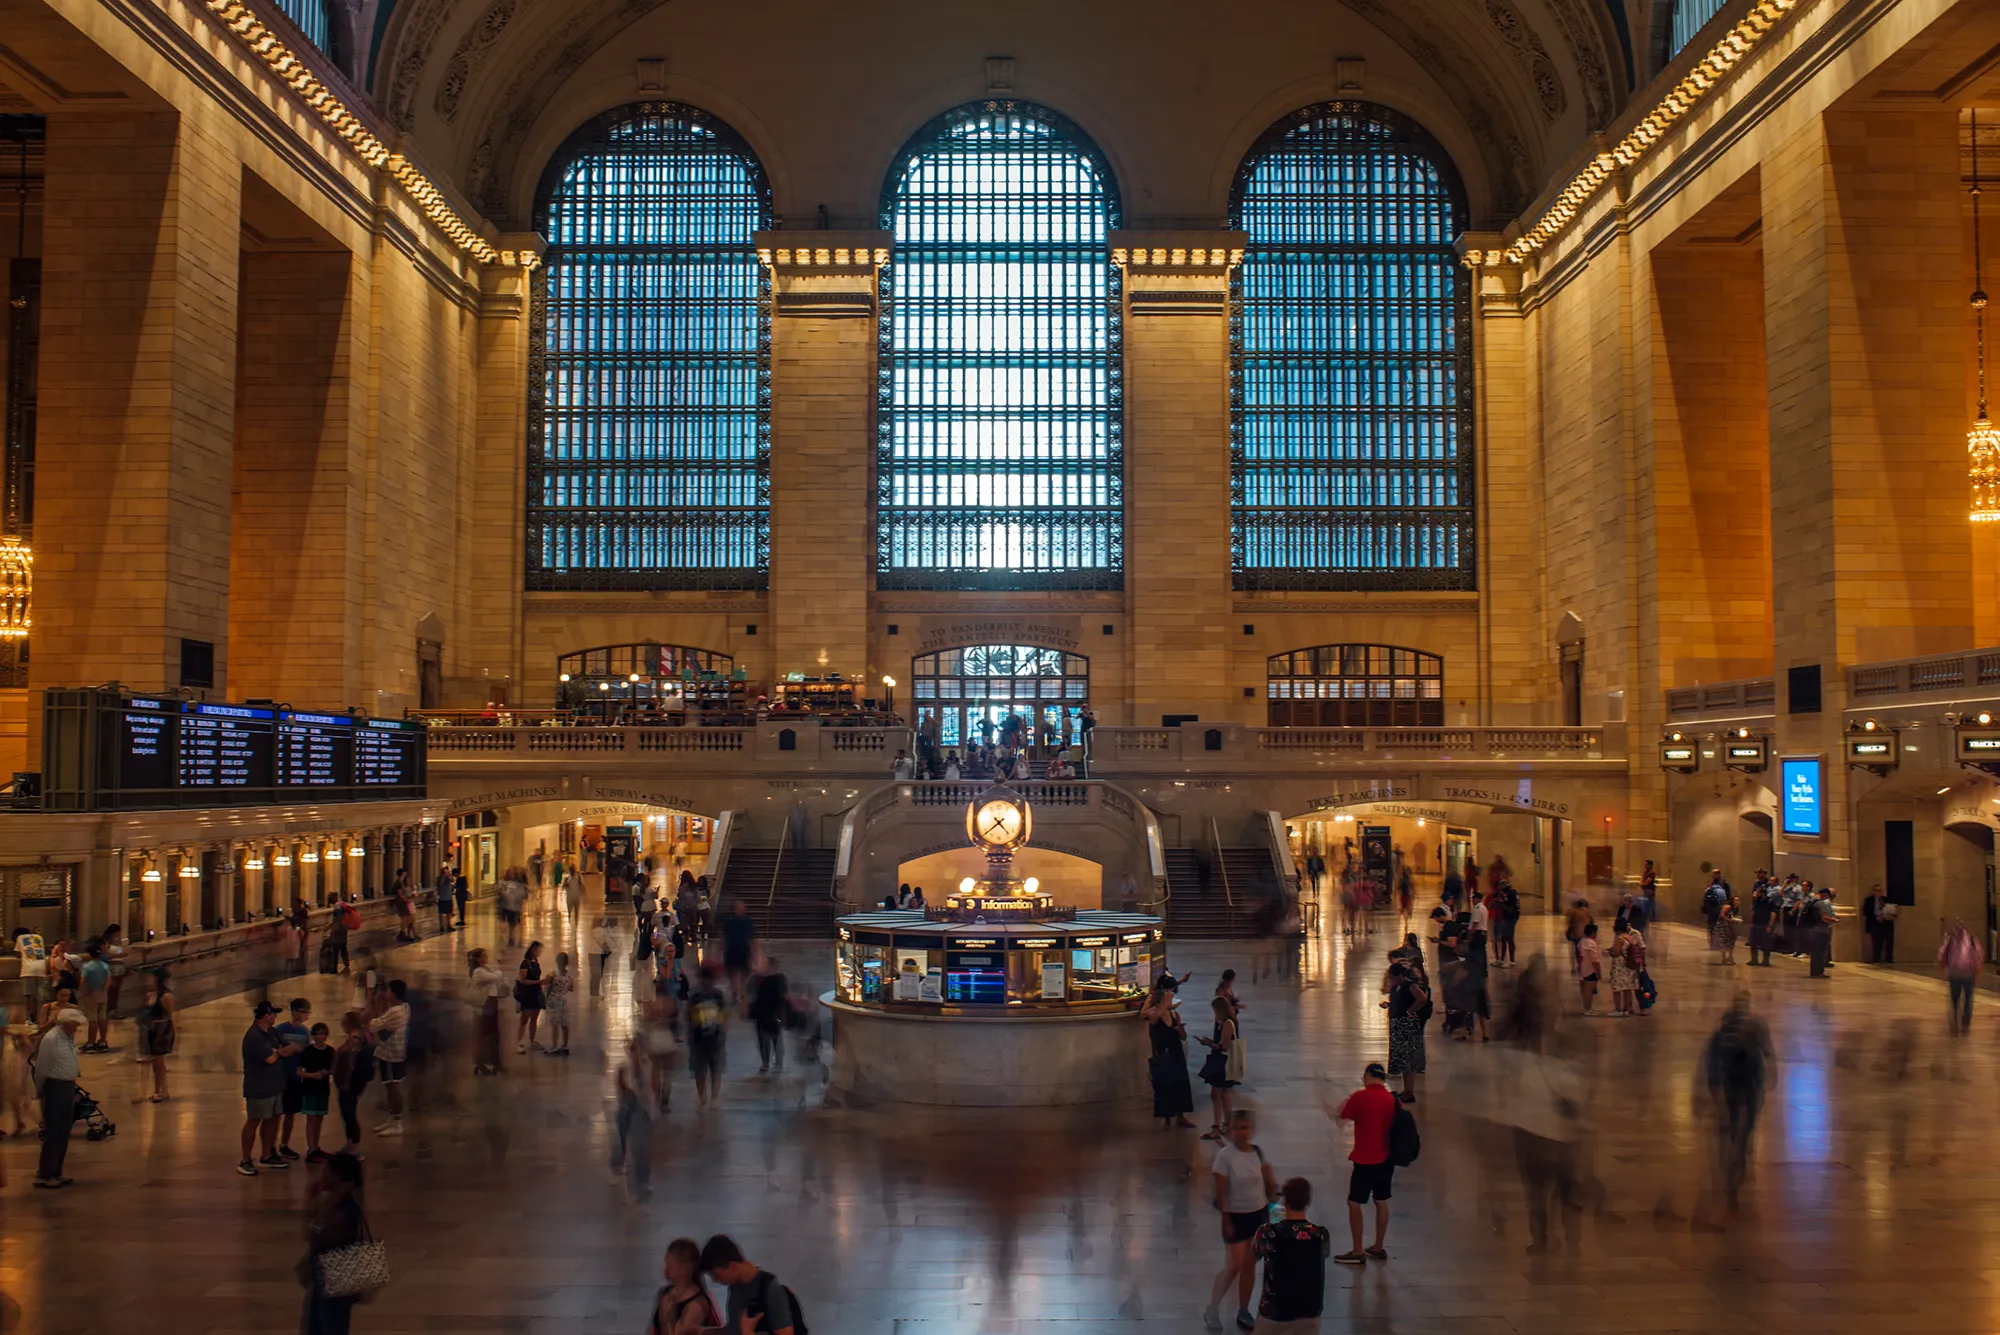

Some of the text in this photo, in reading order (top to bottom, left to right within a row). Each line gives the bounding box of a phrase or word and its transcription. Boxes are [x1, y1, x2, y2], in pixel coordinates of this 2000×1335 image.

[930, 622, 1071, 637] TO VANDERBILT AVENUE
[922, 632, 1079, 649] THE CAMPBELL APARTMENT
[452, 787, 557, 809] TICKET MACHINES
[595, 788, 695, 808] SUBWAY 42ND ST
[1307, 787, 1407, 808] TICKET MACHINES
[1445, 788, 1488, 798] TRACKS
[1532, 799, 1556, 811] LIRR
[580, 806, 620, 816] SUBWAY
[1373, 804, 1447, 818] WAITING ROOM
[981, 899, 1033, 910] Information
